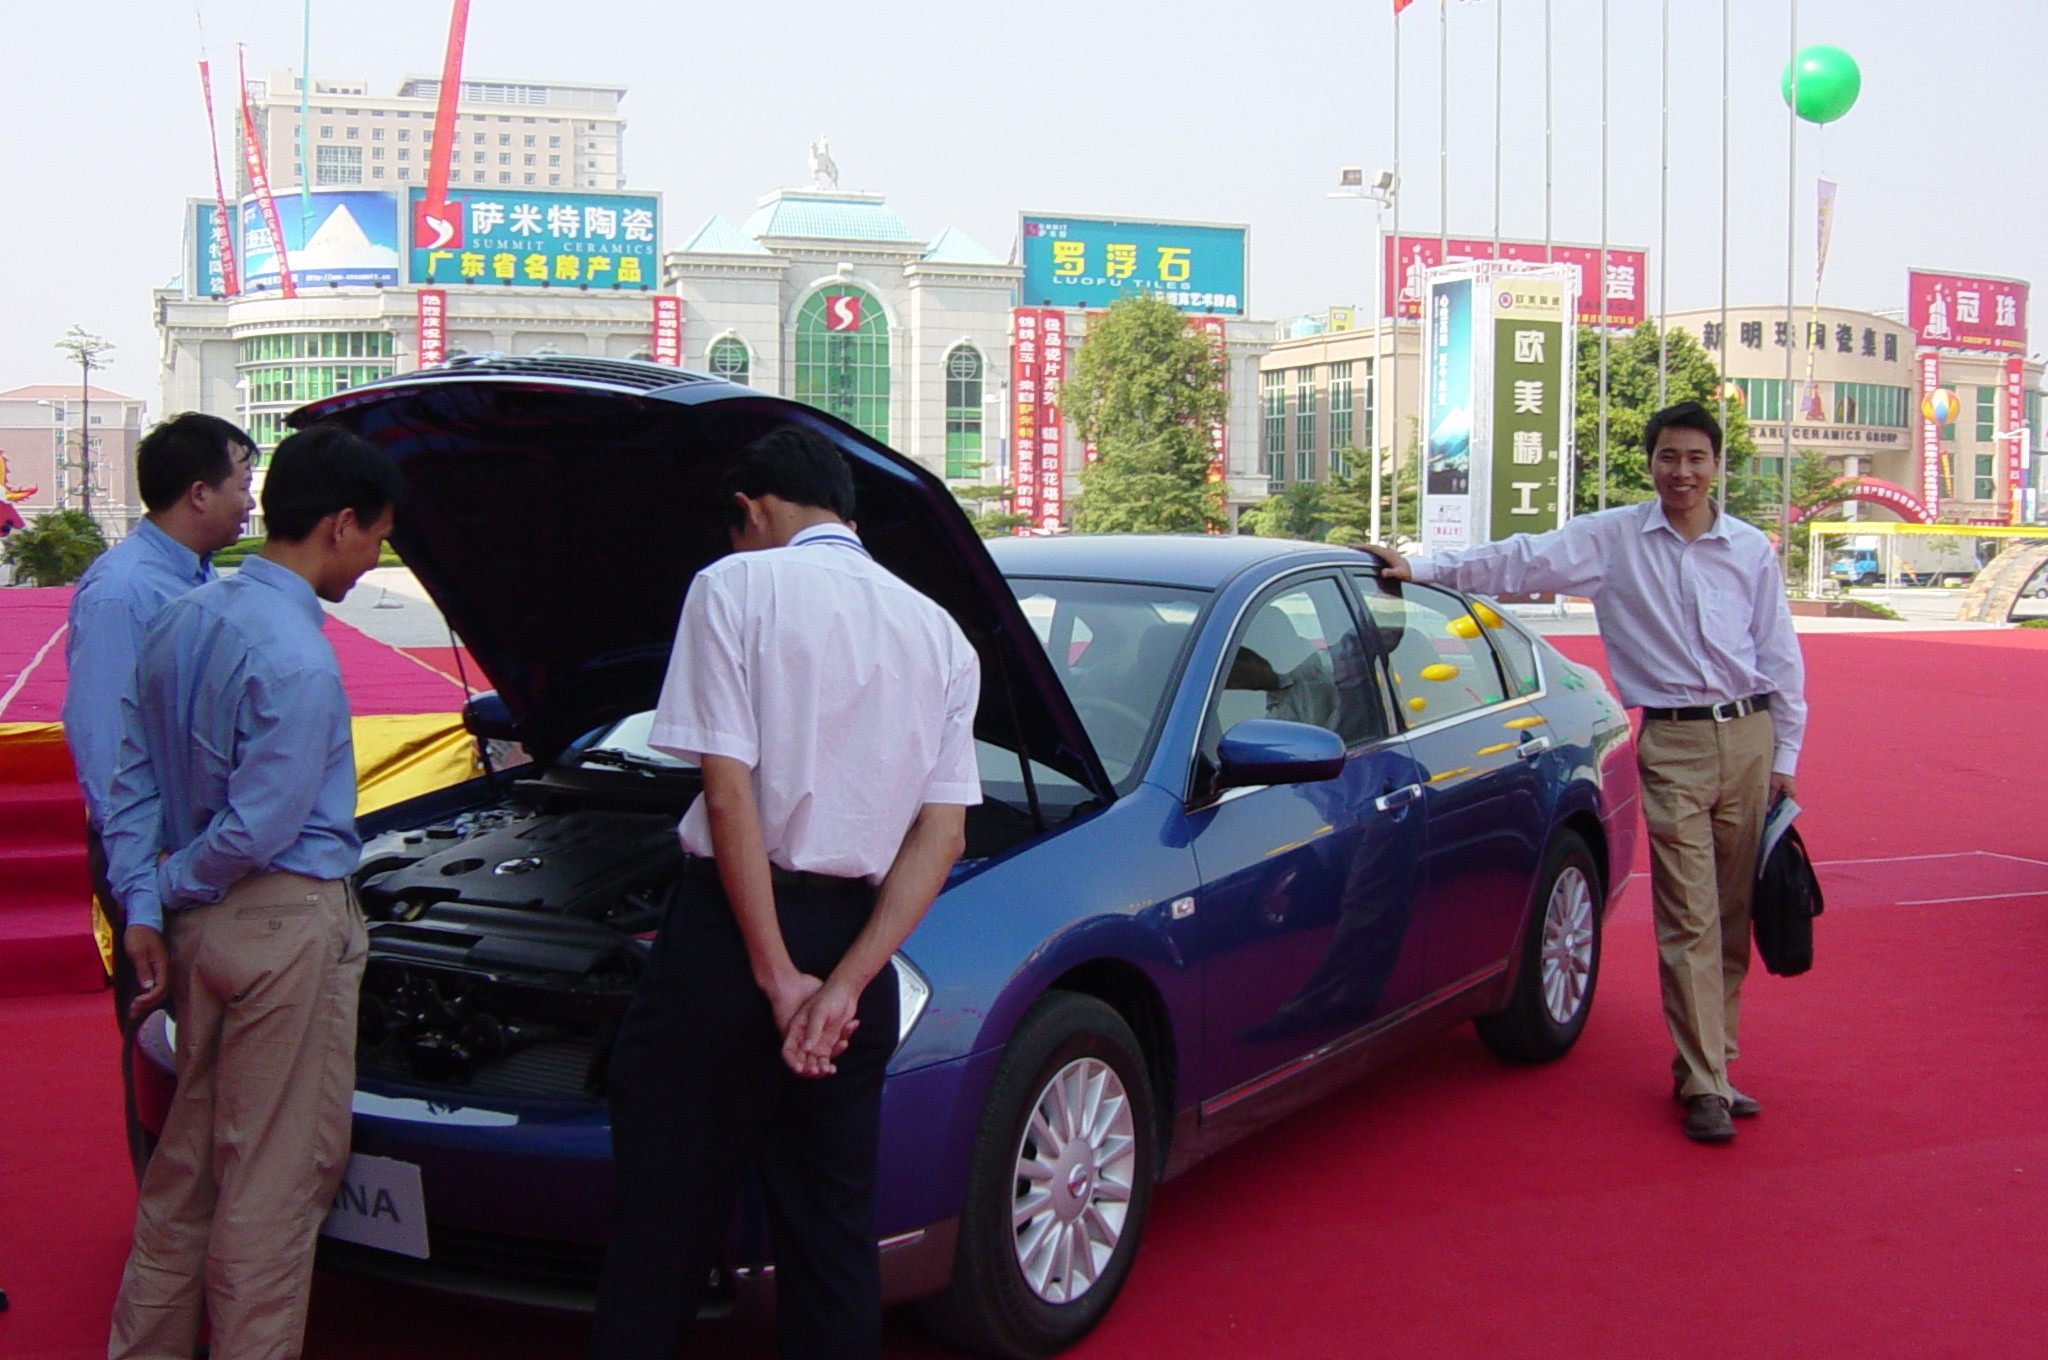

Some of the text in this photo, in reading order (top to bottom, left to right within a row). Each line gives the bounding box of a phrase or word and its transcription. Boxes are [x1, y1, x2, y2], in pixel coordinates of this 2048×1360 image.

[471, 201, 655, 242] 萨米特陶瓷
[472, 239, 654, 255] SUMMIT CERAMICS
[1053, 241, 1191, 281] 罗浮石
[428, 251, 641, 282] 广东省名牌产品
[1053, 277, 1192, 290] LUOFU TILES
[1510, 330, 1545, 516] 欧美精工
[1792, 428, 1861, 441] CERAMICS
